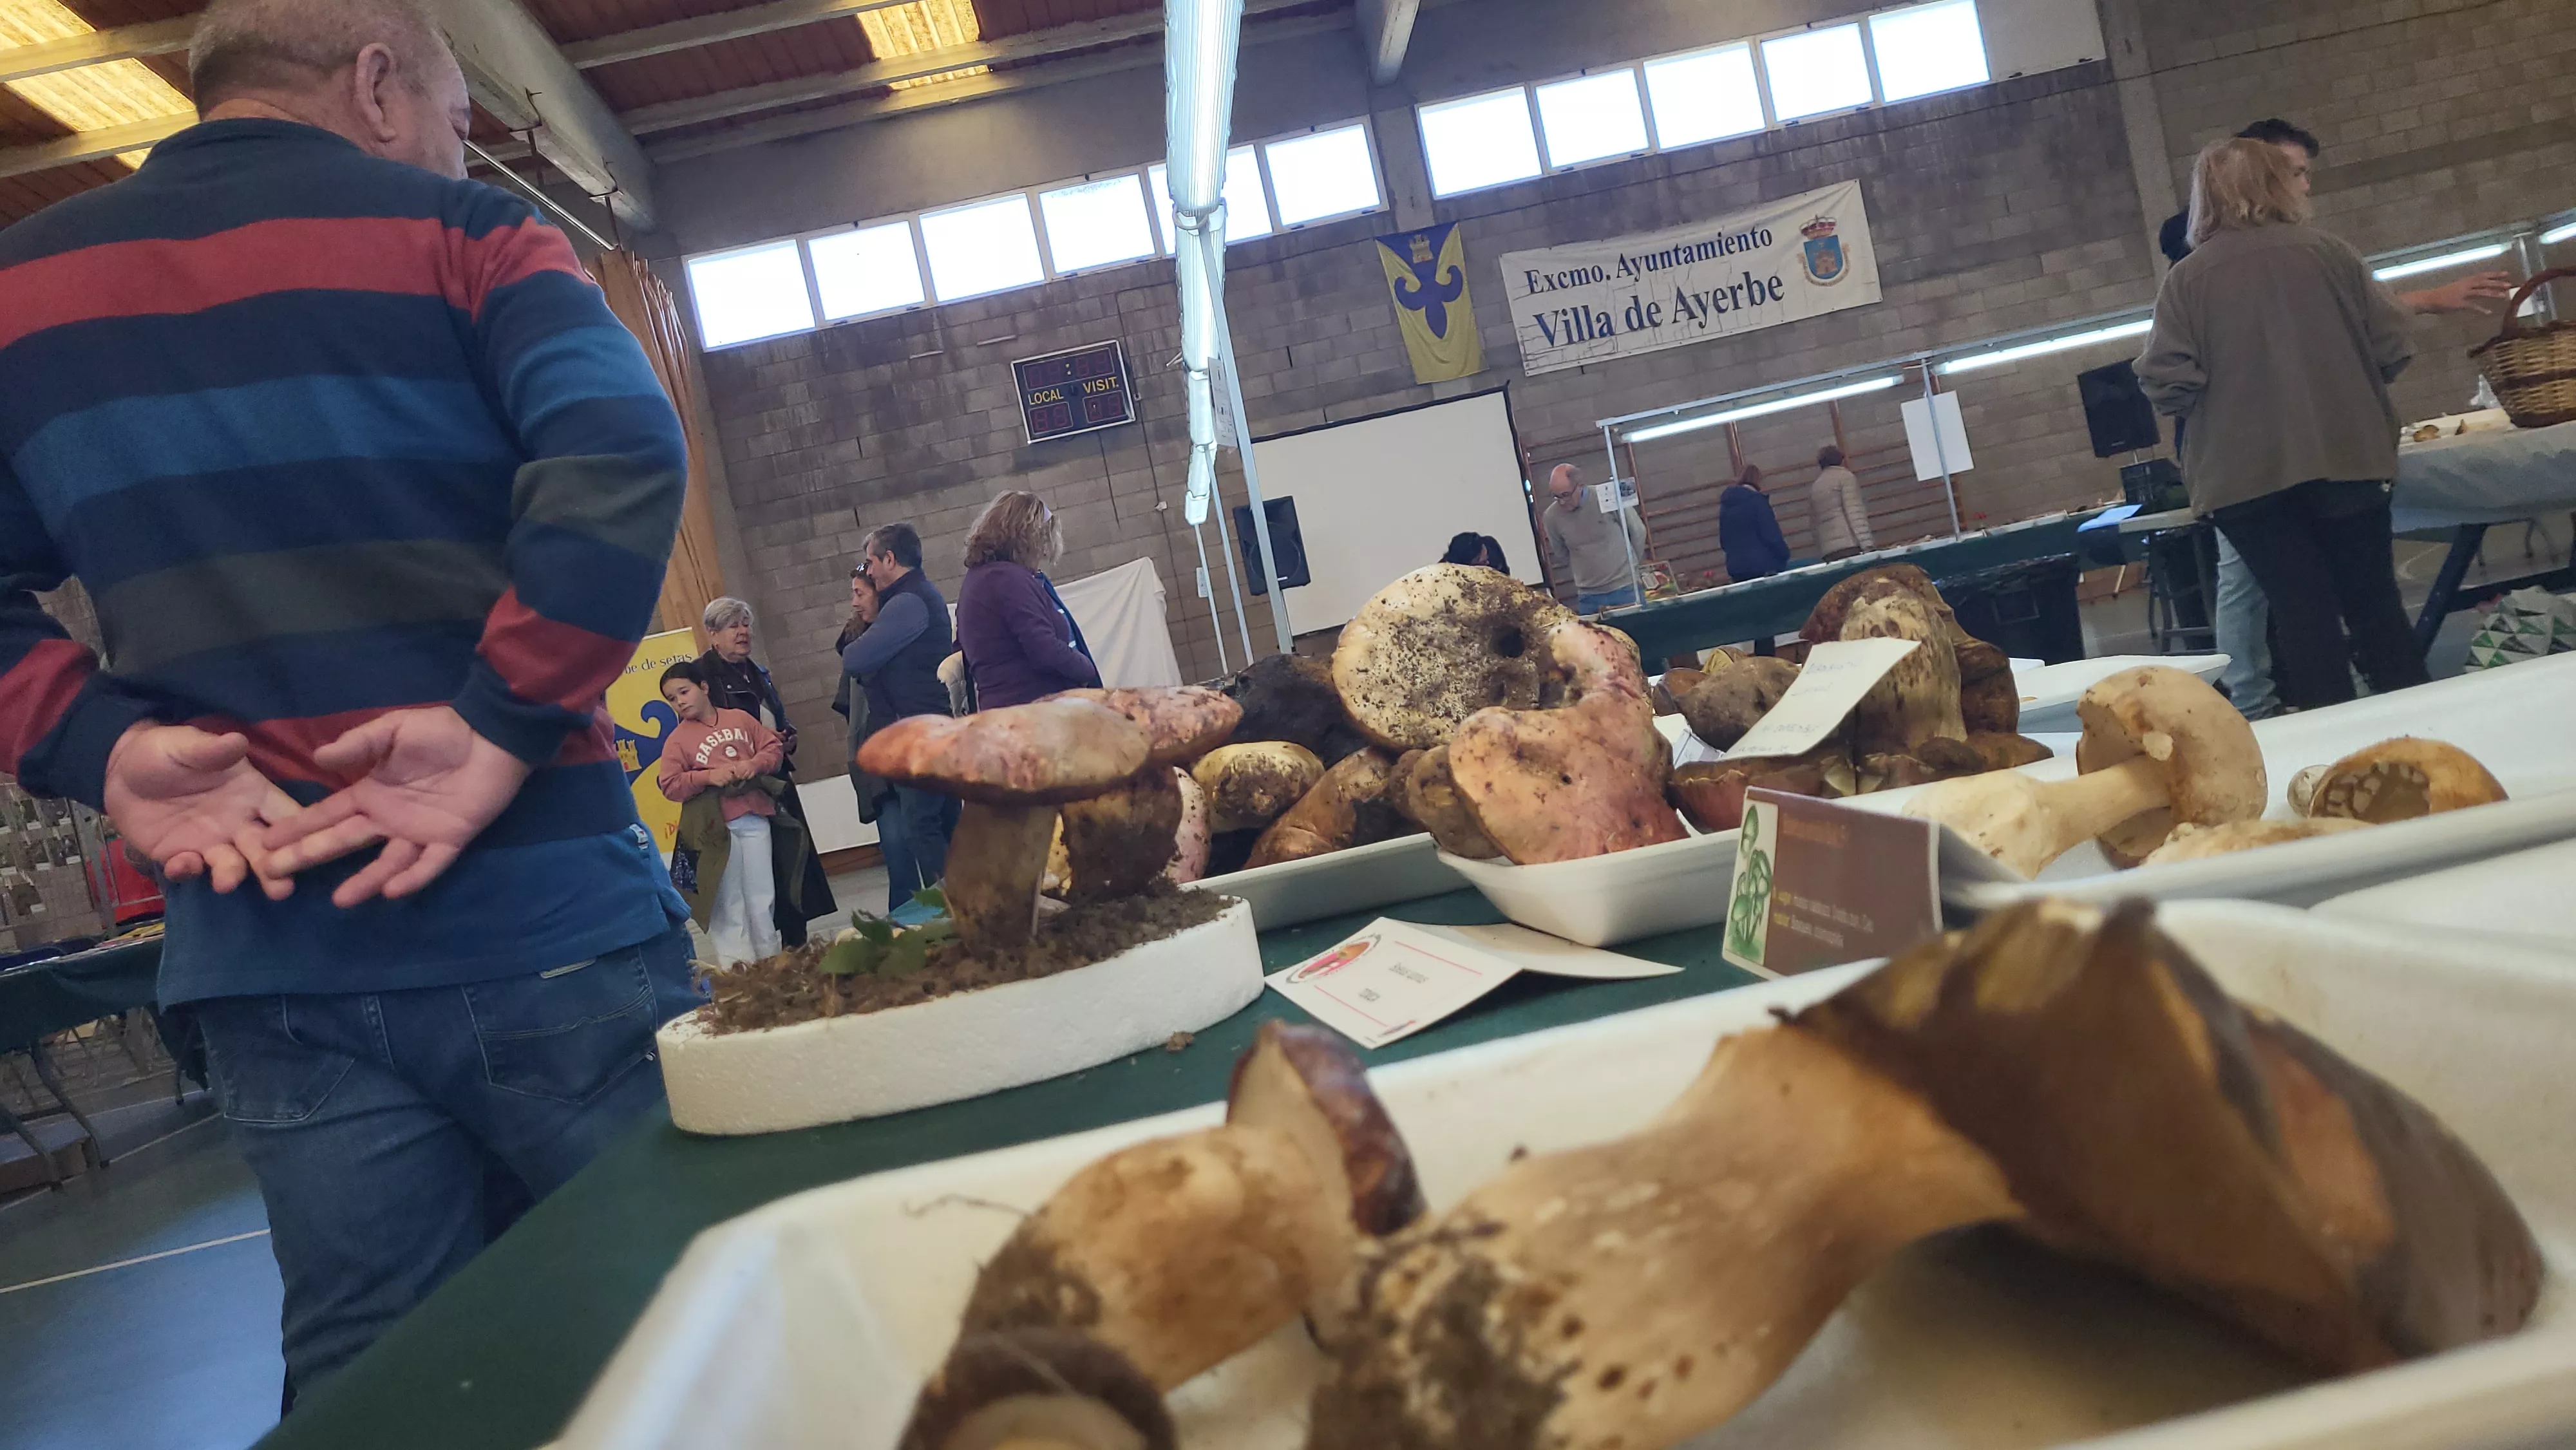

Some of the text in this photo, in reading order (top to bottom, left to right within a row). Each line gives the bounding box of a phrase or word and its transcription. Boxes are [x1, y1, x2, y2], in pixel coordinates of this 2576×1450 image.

[1524, 265, 1611, 294] Excmo.
[1616, 227, 1772, 282] Ayuntamiento
[1532, 305, 1615, 348] Villa
[1625, 295, 1663, 332] de
[1672, 271, 1785, 328] Ayerbe
[1028, 377, 1119, 405] LOCAL VISIT.
[641, 658, 656, 670] de
[659, 653, 692, 667] setas
